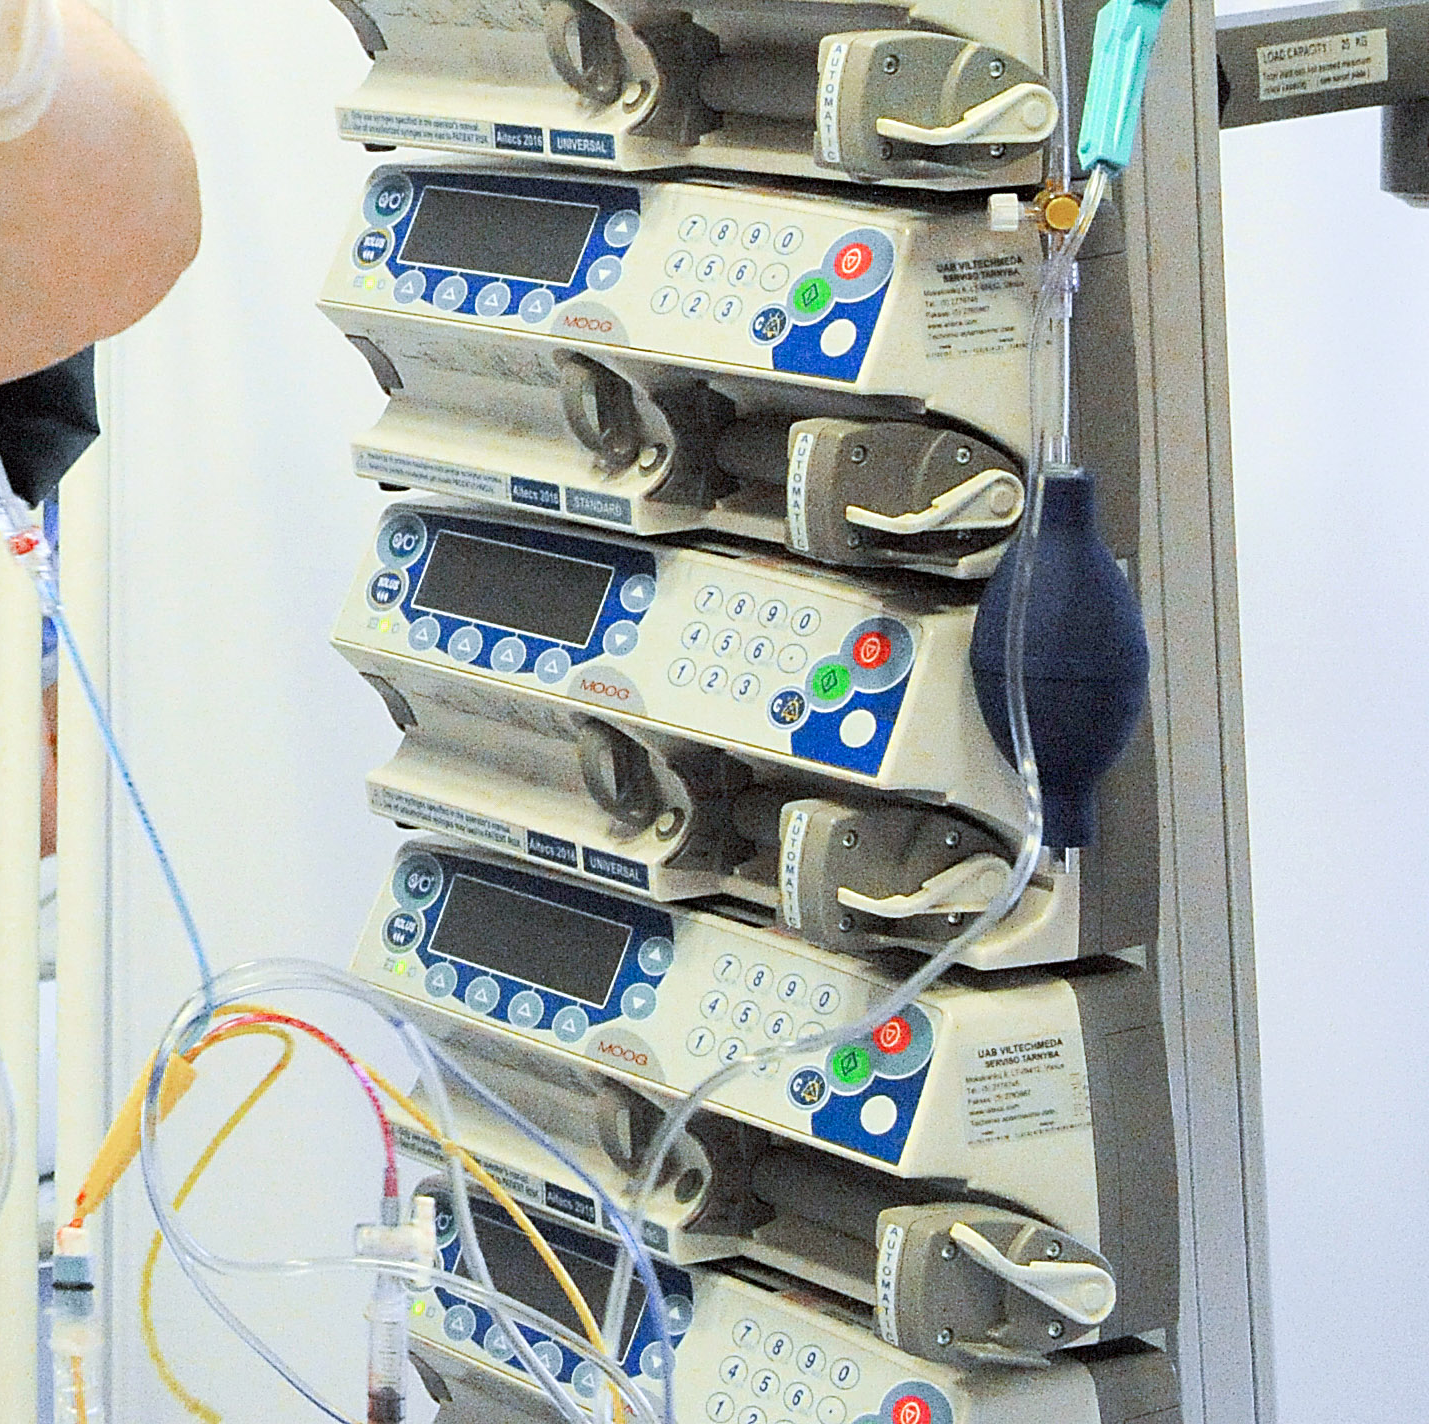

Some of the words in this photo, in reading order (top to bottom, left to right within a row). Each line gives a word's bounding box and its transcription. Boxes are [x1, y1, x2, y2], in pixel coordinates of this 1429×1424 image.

[824, 44, 842, 161] AUTOMATIC
[523, 134, 543, 147] 2016
[557, 137, 607, 153] UNIVERSAL
[686, 220, 698, 236] 7
[717, 224, 730, 241] 8
[749, 228, 761, 244] 9
[781, 231, 794, 249] 0
[673, 257, 685, 274] 4
[703, 260, 716, 277] 5
[735, 264, 748, 281] 6
[659, 293, 669, 308] 1
[689, 296, 702, 313] 2
[721, 300, 734, 318] 3
[563, 315, 613, 333] MOOG
[573, 496, 622, 516] STANDARD
[702, 591, 715, 607] 7
[734, 598, 746, 615] 8
[766, 605, 778, 622] 9
[799, 613, 812, 630] 0
[689, 628, 701, 644] 4
[720, 634, 733, 652] 5
[753, 642, 765, 659] 6
[580, 679, 630, 701] MOOG
[676, 664, 687, 680] 1
[706, 671, 719, 689] 2
[738, 679, 751, 696] 3
[590, 856, 640, 880] UNIVERSAL
[720, 960, 733, 976] 7
[752, 970, 765, 987] 8
[785, 980, 797, 997] 9
[819, 990, 831, 1008] 0
[708, 998, 720, 1014] 4
[739, 1006, 752, 1024] 5
[772, 1017, 784, 1035] 6
[598, 1040, 648, 1066] MOOG
[695, 1034, 705, 1050] 1
[725, 1044, 738, 1061] 2
[977, 1047, 998, 1059] UAB
[999, 1038, 1064, 1055] VILTECHMEDA
[984, 1056, 1020, 1068] SERVISO
[1022, 1050, 1060, 1063] TARNYBA
[881, 1226, 898, 1343] AUTOMATIC
[740, 1325, 752, 1341] 7
[772, 1338, 784, 1356] 8
[804, 1351, 817, 1369] 9
[838, 1365, 850, 1382] 0
[728, 1364, 739, 1380] 4
[759, 1375, 772, 1393] 5
[792, 1389, 804, 1406] 6
[715, 1400, 725, 1416] 1
